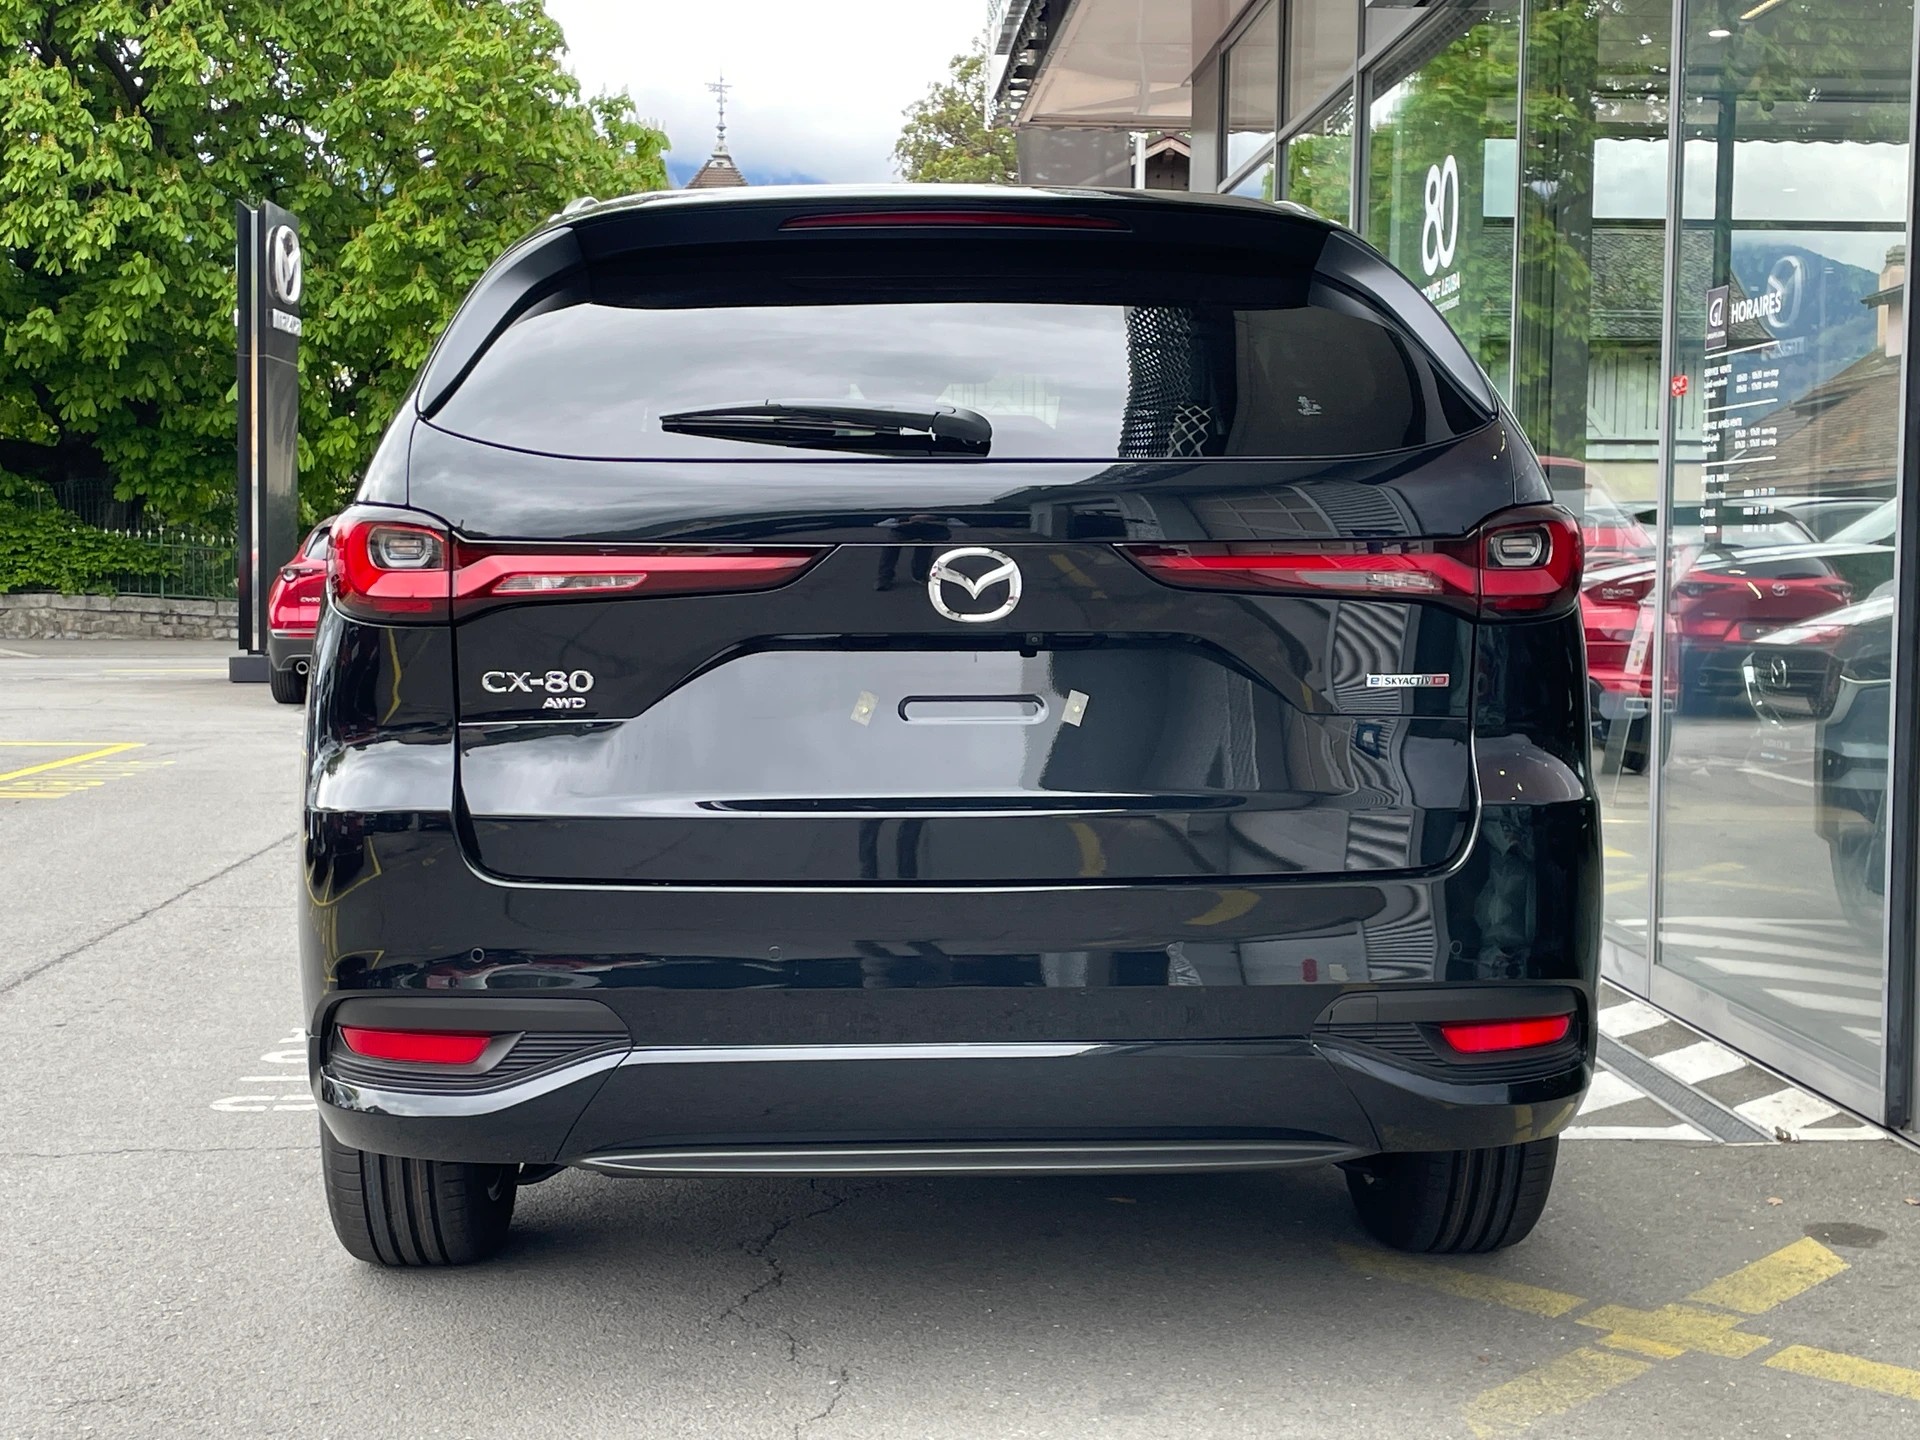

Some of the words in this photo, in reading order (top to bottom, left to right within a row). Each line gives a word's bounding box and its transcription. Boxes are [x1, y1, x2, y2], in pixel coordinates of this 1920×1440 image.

[1421, 154, 1459, 276] 80
[1731, 291, 1782, 324] HORAIRES
[481, 669, 594, 693] CX-80
[1384, 676, 1431, 686] SKYACTIV
[542, 697, 587, 709] AWD
